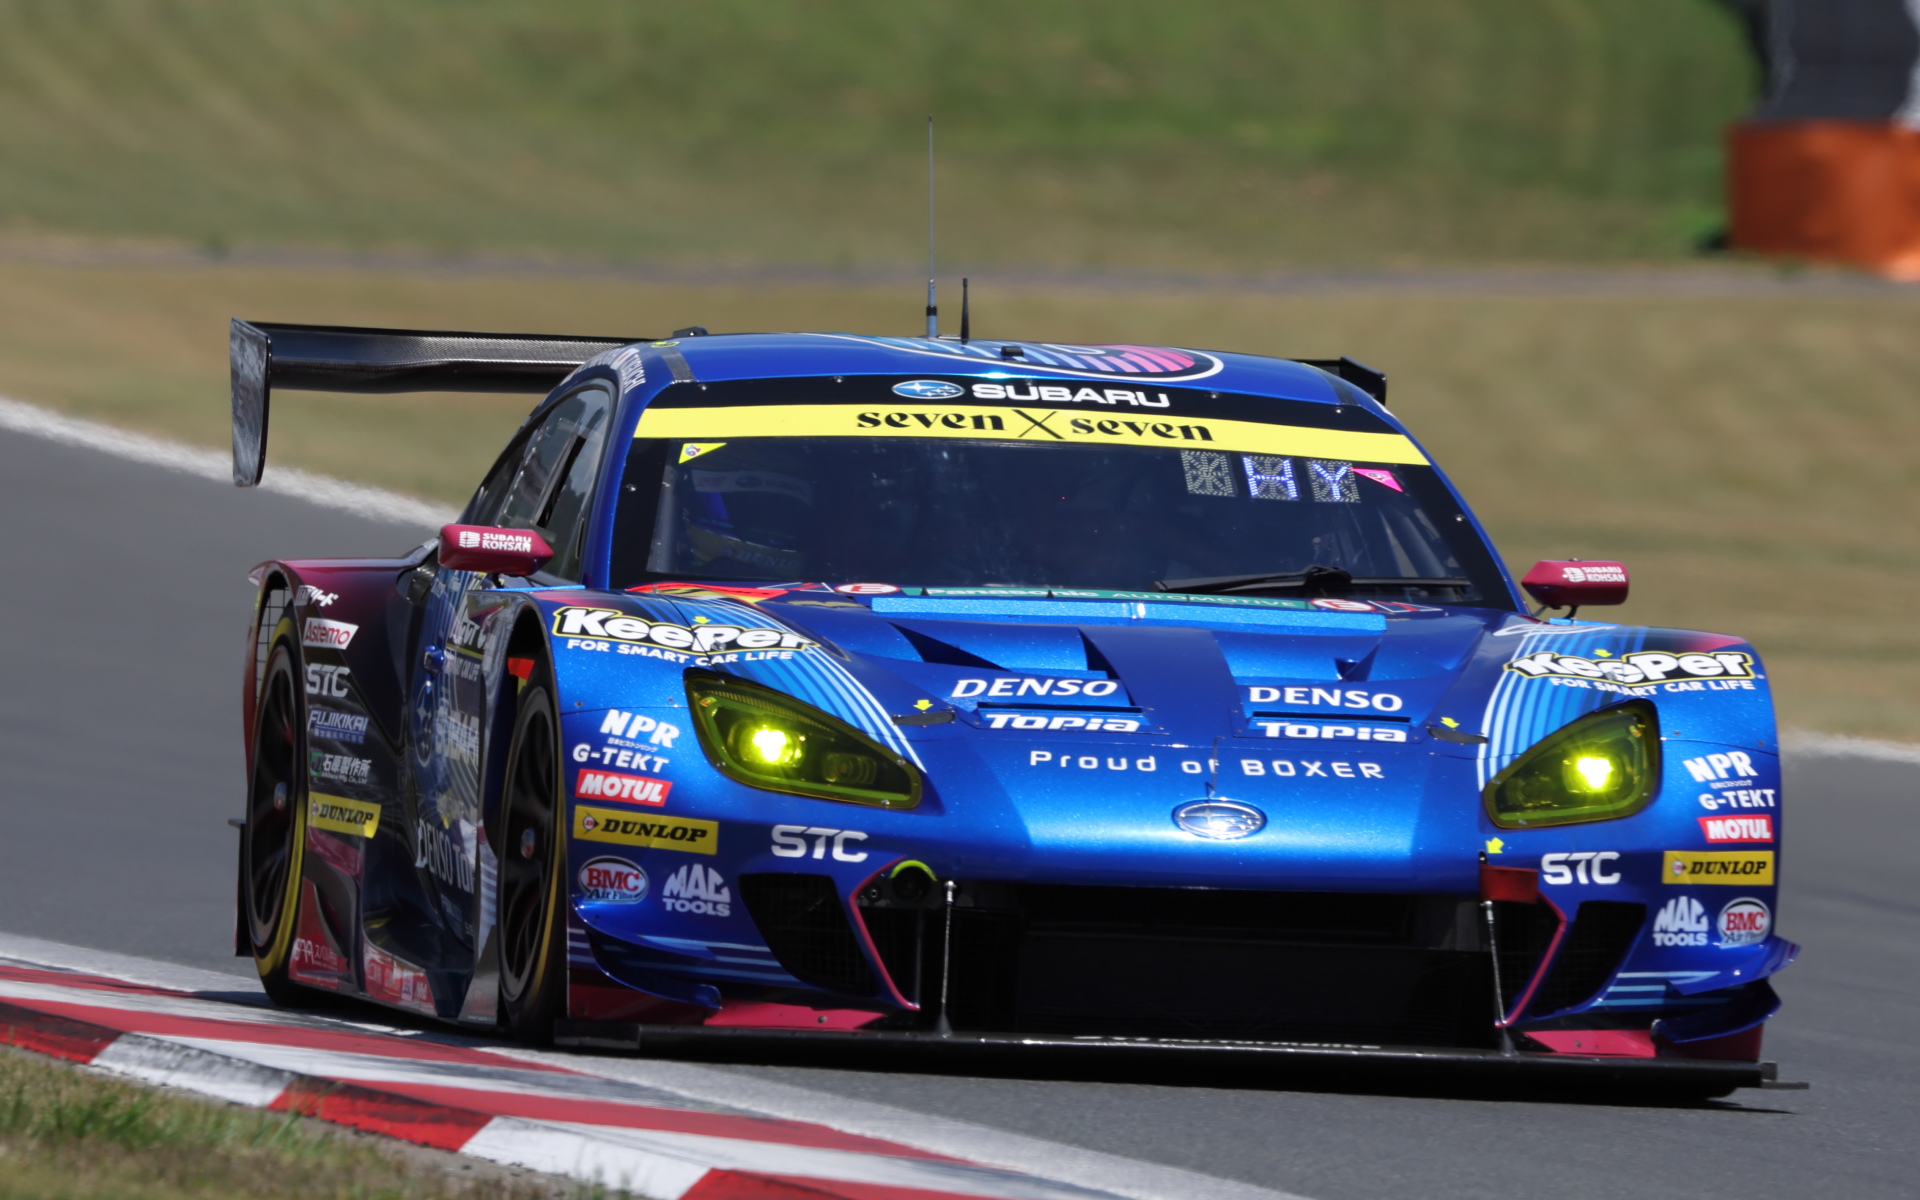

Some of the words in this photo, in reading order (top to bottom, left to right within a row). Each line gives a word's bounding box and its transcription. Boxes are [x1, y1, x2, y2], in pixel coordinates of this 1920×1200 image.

[972, 383, 1171, 408] SUBARU
[856, 408, 1007, 432] seven
[1071, 416, 1216, 442] seven
[482, 532, 532, 543] SUBARU
[482, 540, 532, 552] KOHSAN
[1586, 573, 1626, 582] KOHSAN
[925, 588, 1099, 598] Panasonic
[1113, 592, 1297, 607] AUTOMOTIVE
[304, 621, 351, 645] Astemo
[562, 608, 813, 652] KeePer
[567, 639, 610, 653] FOR
[617, 643, 690, 664] SMART
[695, 652, 738, 666] CAR
[745, 651, 793, 661] LIFE
[306, 662, 351, 698] STC
[1512, 652, 1748, 684] KeePer
[951, 677, 1119, 699] DENSO
[1249, 686, 1403, 712] DENSO
[1550, 677, 1592, 689] FOR
[1596, 681, 1659, 697] SMART
[1664, 681, 1708, 693] CAR
[1710, 679, 1756, 690] LIFE
[308, 710, 369, 732] FUJIKIKAI
[600, 708, 680, 749] NPR
[573, 744, 670, 773] G-TEKT
[1030, 750, 1157, 772] Proud
[1181, 758, 1220, 774] of
[1241, 759, 1385, 779] BOXER
[1682, 751, 1759, 782] NPR
[579, 772, 664, 803] MOTUL
[1698, 789, 1775, 810] G-TEKT
[319, 804, 374, 826] DUNLOP
[601, 817, 708, 843] DUNLOP
[1706, 818, 1771, 839] MOTUL
[416, 818, 453, 887] DENSO
[771, 824, 869, 863] STC
[587, 868, 640, 892] BMC
[1541, 851, 1622, 885] STC
[1688, 860, 1767, 876] DUNLOP
[663, 863, 731, 902] MAC
[663, 899, 731, 917] TOOLS
[1654, 895, 1708, 931] MAC
[1725, 911, 1765, 931] BMC
[1653, 931, 1709, 946] TOOLS
